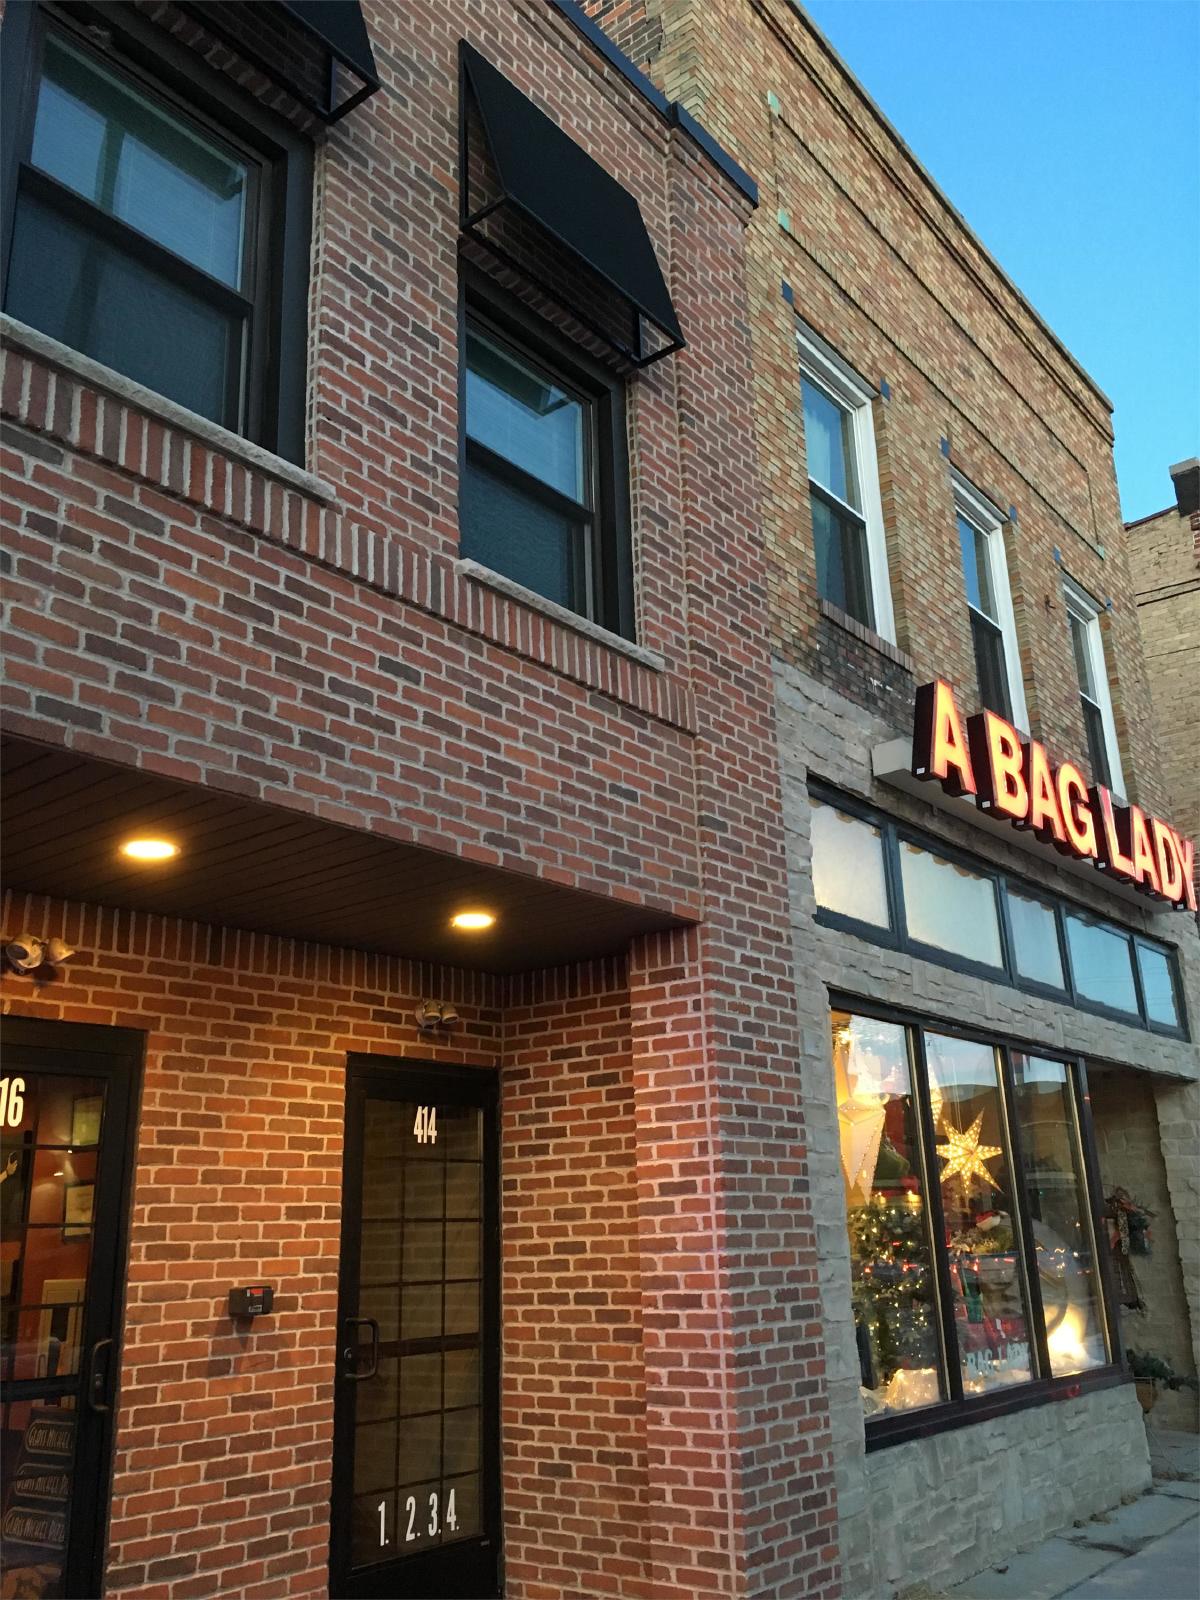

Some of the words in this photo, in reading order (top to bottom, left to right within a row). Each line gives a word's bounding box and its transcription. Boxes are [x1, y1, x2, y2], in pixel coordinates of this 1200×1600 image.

[931, 678, 977, 795] A
[984, 708, 1098, 858] BAG
[1100, 783, 1198, 912] LADY
[413, 1105, 438, 1144] 414
